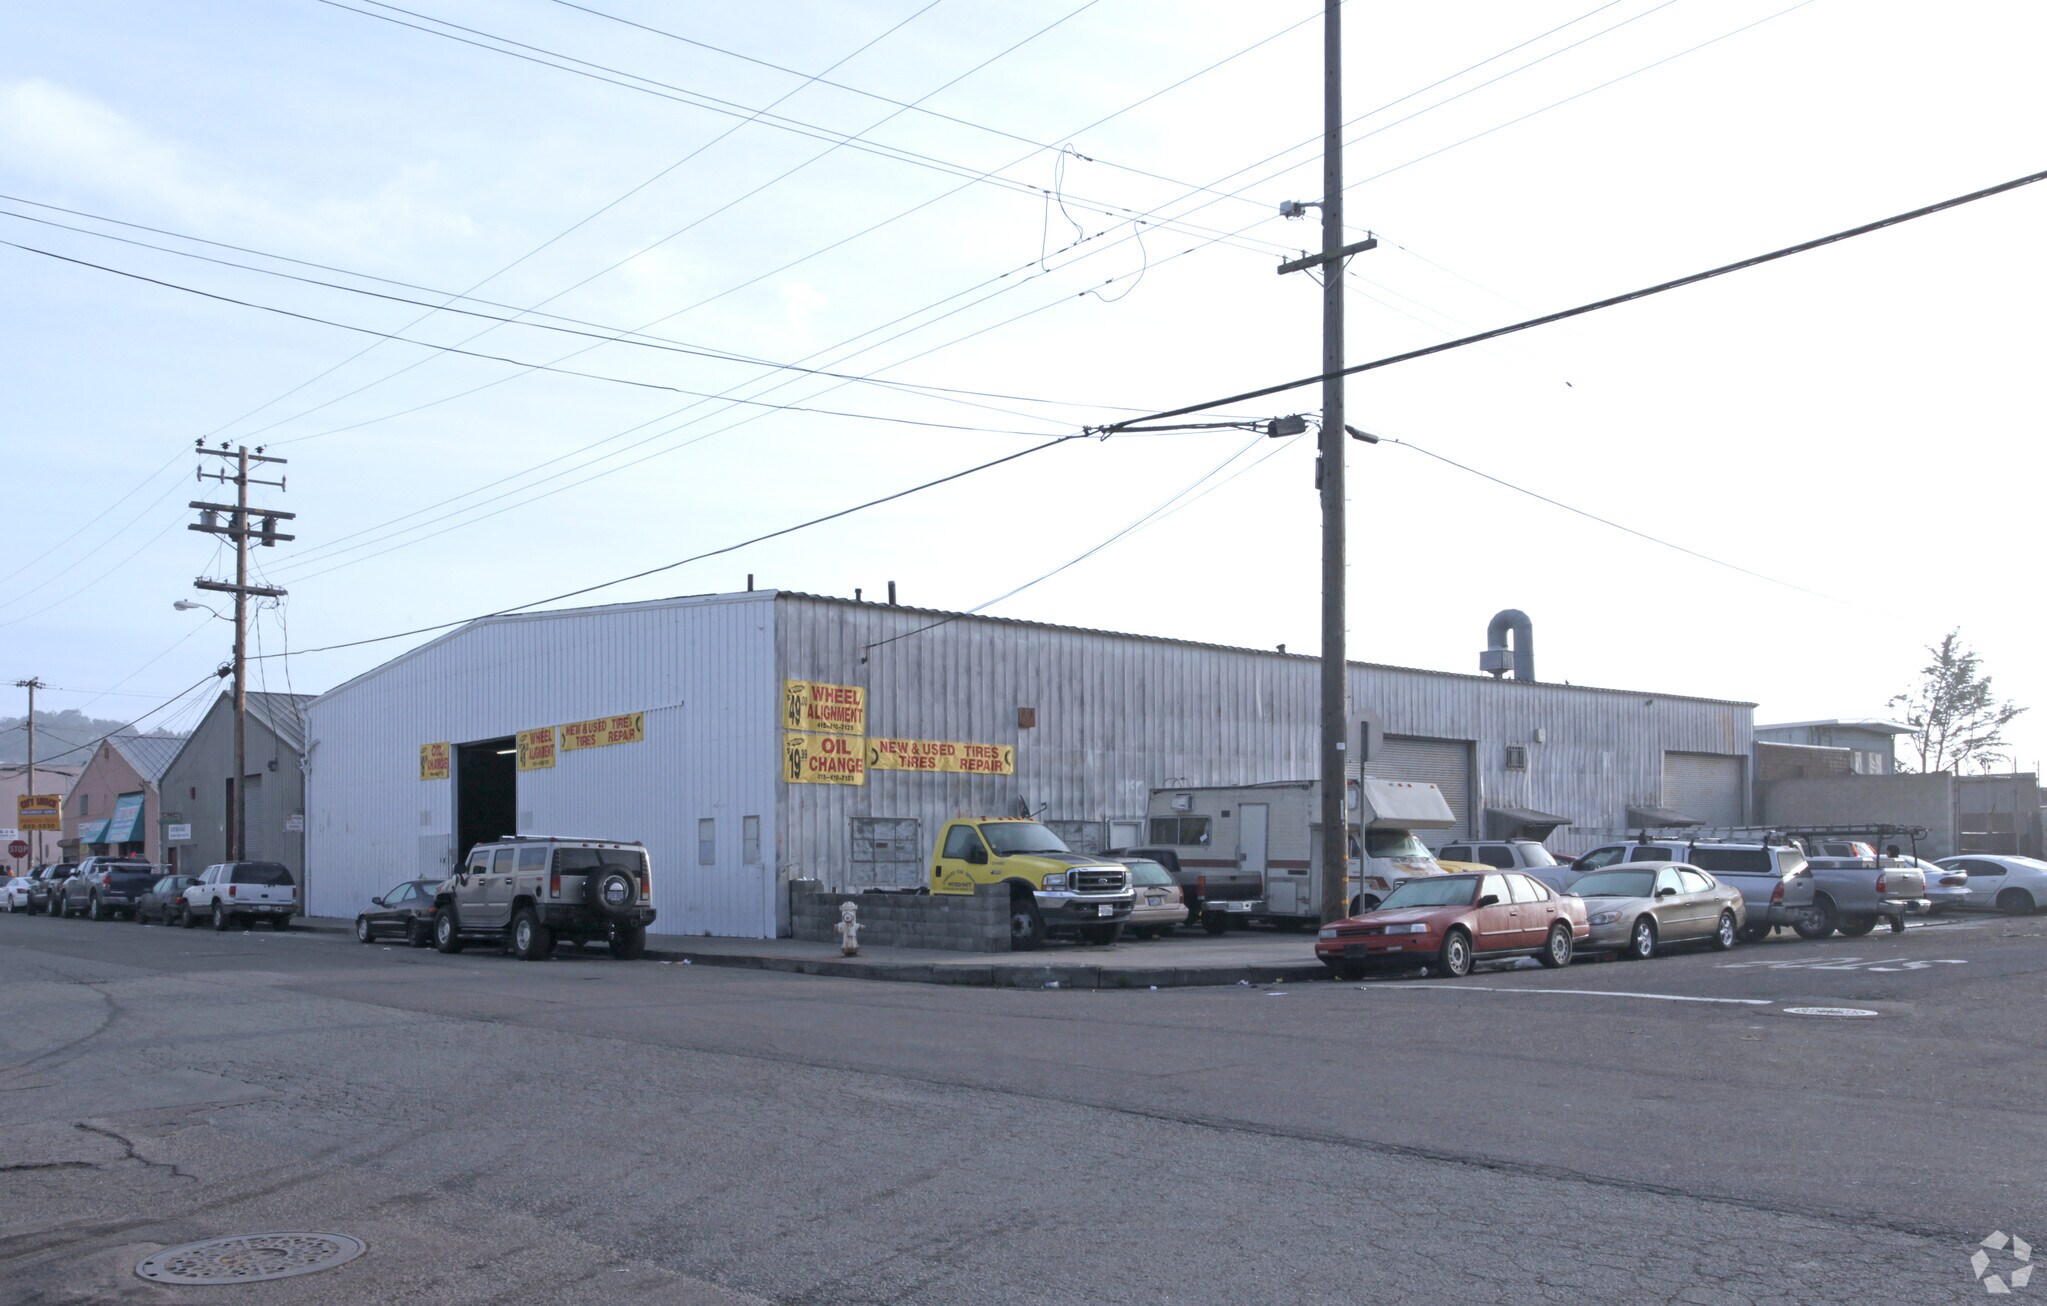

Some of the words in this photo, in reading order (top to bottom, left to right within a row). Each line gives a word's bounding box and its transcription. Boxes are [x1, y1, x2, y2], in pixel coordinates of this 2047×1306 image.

[811, 685, 860, 705] WHEEL
[807, 704, 863, 723] ALIGNMENT
[566, 724, 581, 736] NEW
[582, 722, 588, 735] &
[588, 720, 607, 734] USED
[608, 728, 635, 742] REPAIR
[576, 734, 596, 747] TIRES
[821, 737, 852, 756] OIL
[880, 740, 909, 754] NEW
[911, 742, 920, 755] &
[923, 743, 955, 756] USED
[964, 745, 1000, 758] TIRES
[809, 755, 863, 773] CHANGE
[899, 755, 936, 768] TIRES
[960, 758, 1003, 772] REPAIR
[9, 845, 29, 853] STOP
